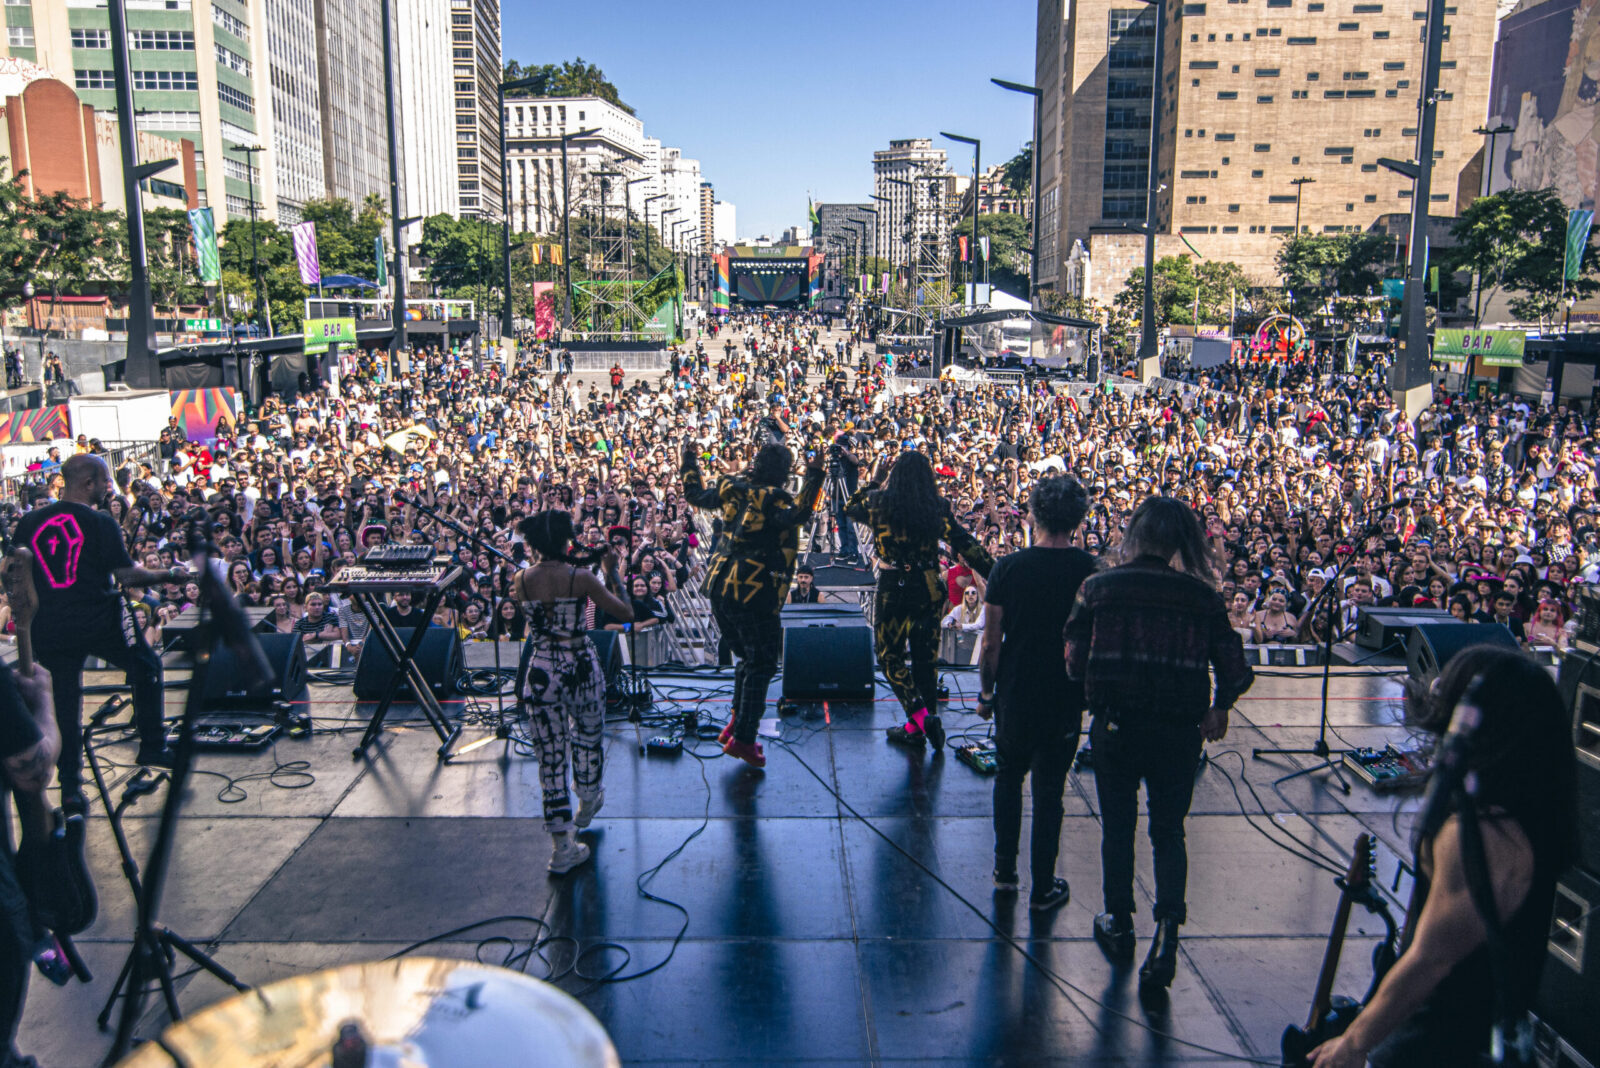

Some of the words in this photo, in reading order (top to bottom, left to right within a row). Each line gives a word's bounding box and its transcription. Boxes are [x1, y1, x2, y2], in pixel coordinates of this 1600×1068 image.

[758, 247, 781, 255] MITA
[324, 323, 341, 337] BAR
[1462, 334, 1493, 350] BAR
